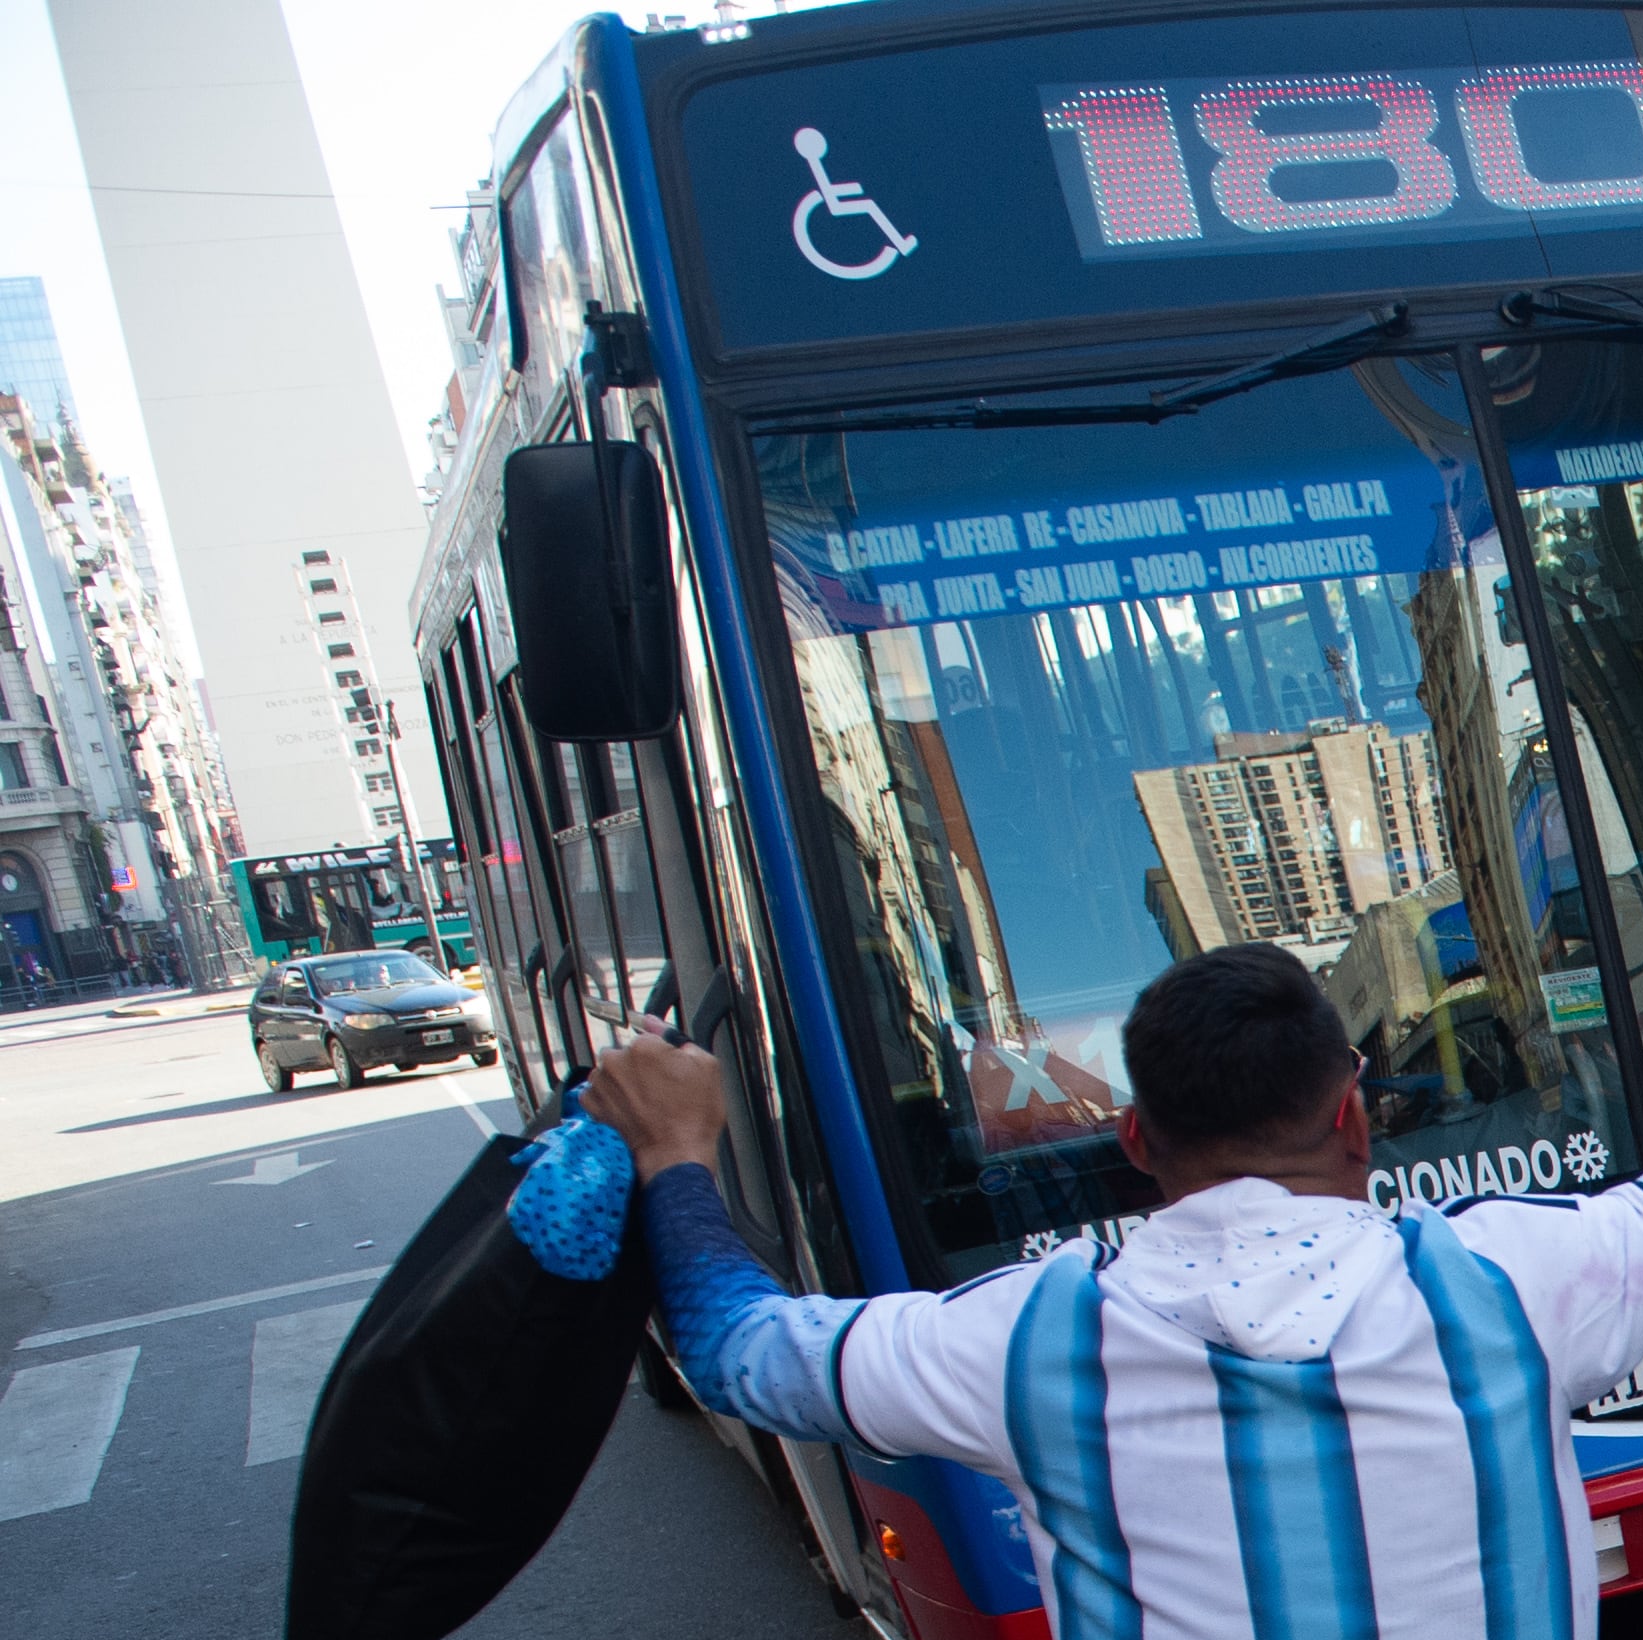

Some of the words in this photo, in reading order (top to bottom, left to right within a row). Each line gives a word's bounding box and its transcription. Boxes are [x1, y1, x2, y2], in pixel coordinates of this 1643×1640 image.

[1066, 497, 1188, 546] CASANOVA
[1195, 487, 1295, 533] TABLADA
[878, 580, 934, 624] PRA
[933, 572, 1009, 617] JUNTA
[1015, 565, 1066, 608] SAN
[1063, 557, 1123, 602] JUAN
[1130, 550, 1208, 595] BOEDO
